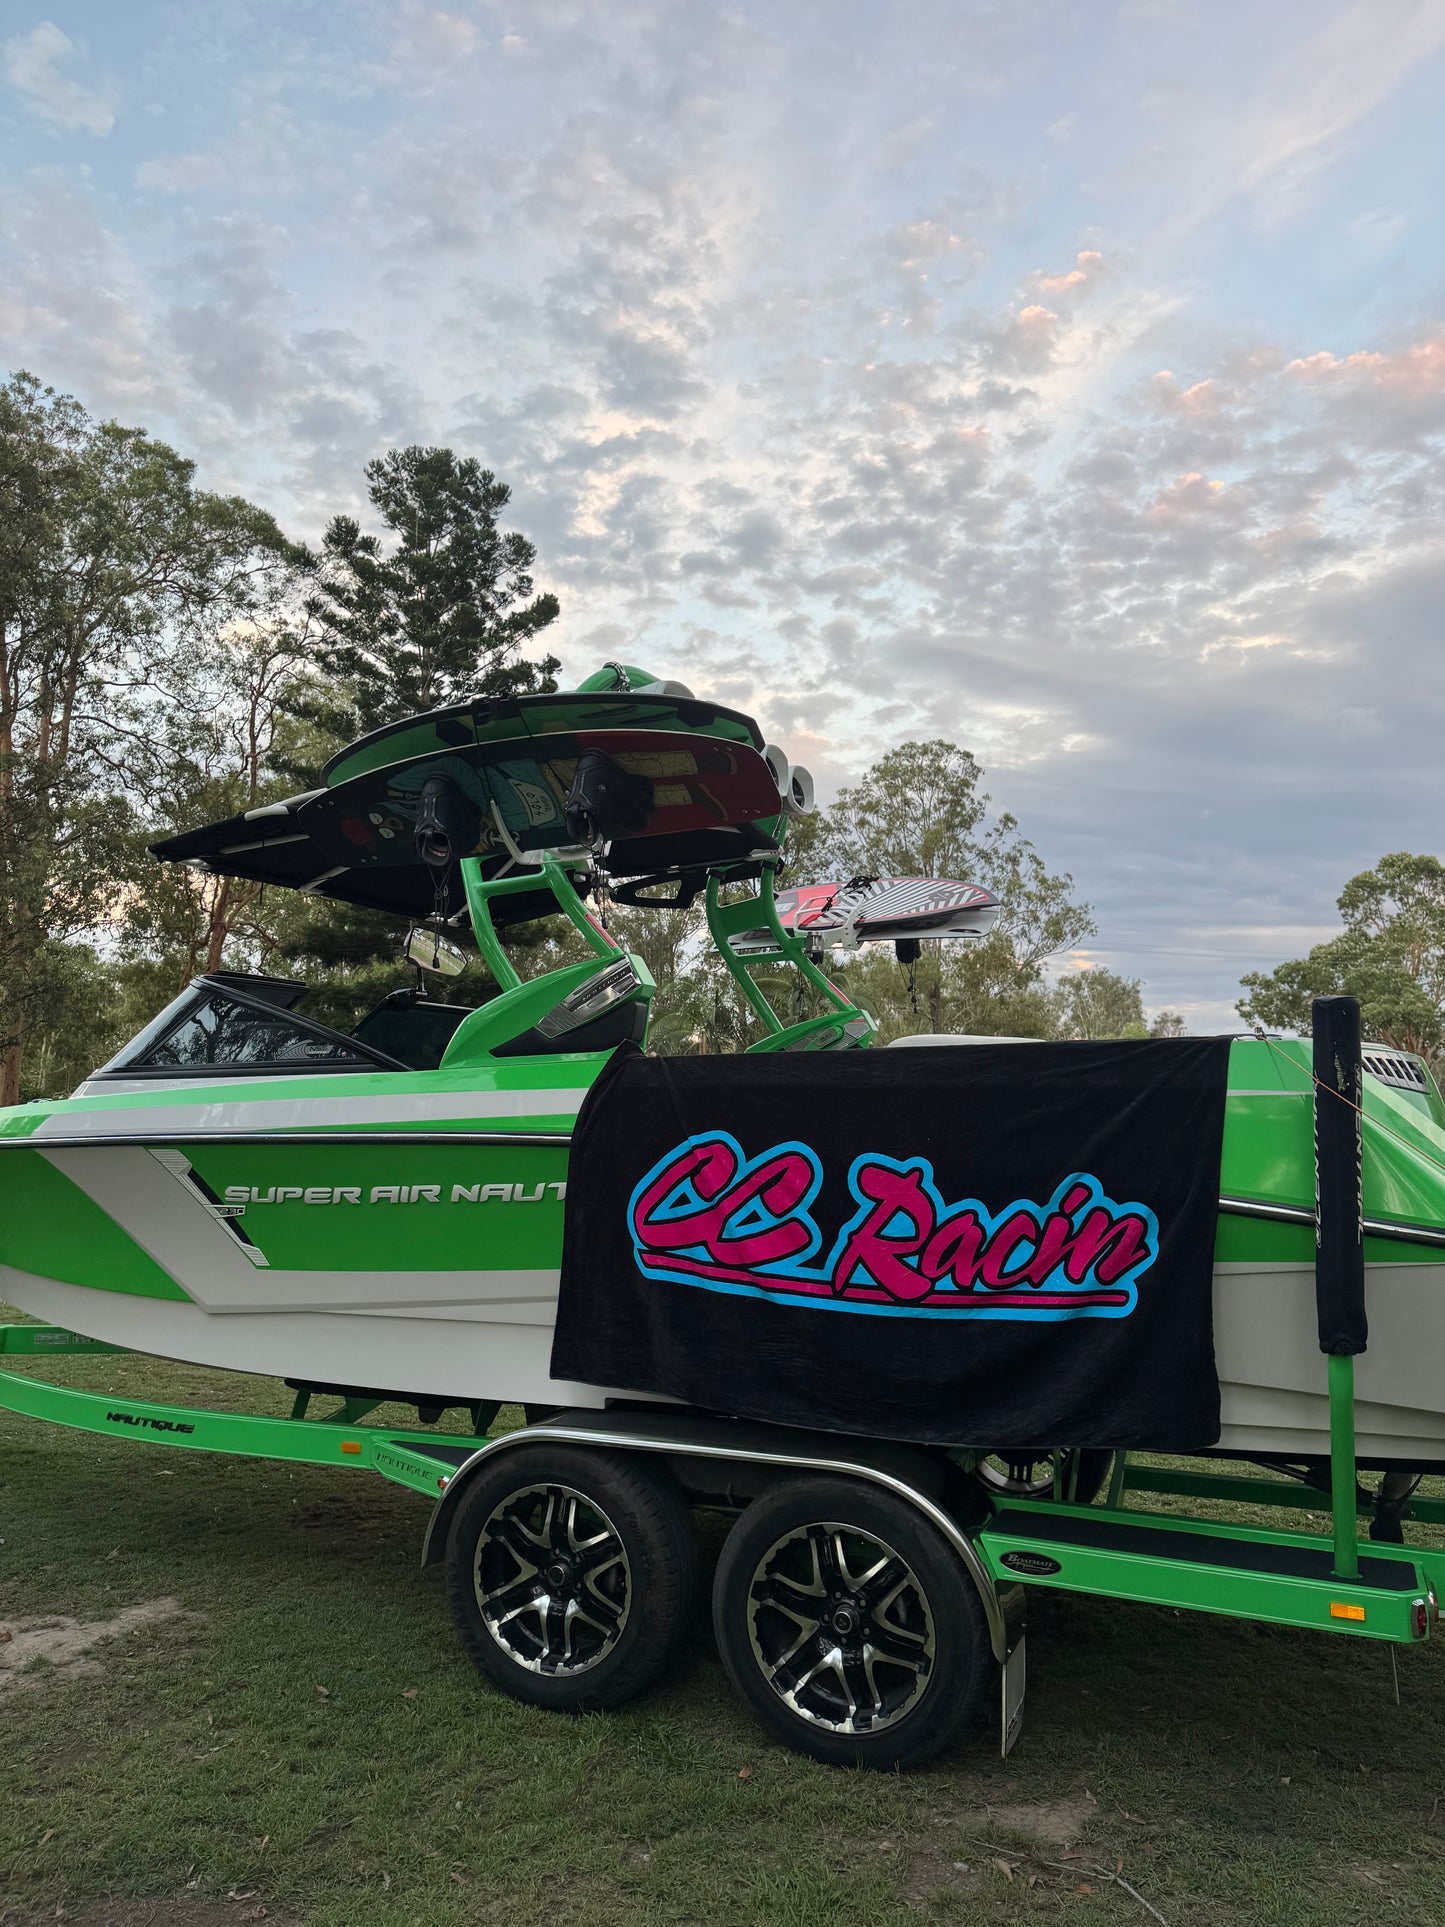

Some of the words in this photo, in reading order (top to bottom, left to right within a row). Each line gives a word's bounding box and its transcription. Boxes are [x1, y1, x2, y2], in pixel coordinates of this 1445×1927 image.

[225, 1186, 362, 1204] SUPER
[370, 1184, 442, 1203] AIR
[450, 1181, 568, 1203] NAUT
[832, 1163, 1148, 1302] Racin
[106, 1412, 196, 1434] NAUTIQUE
[376, 1453, 433, 1479] NAUTIQUE
